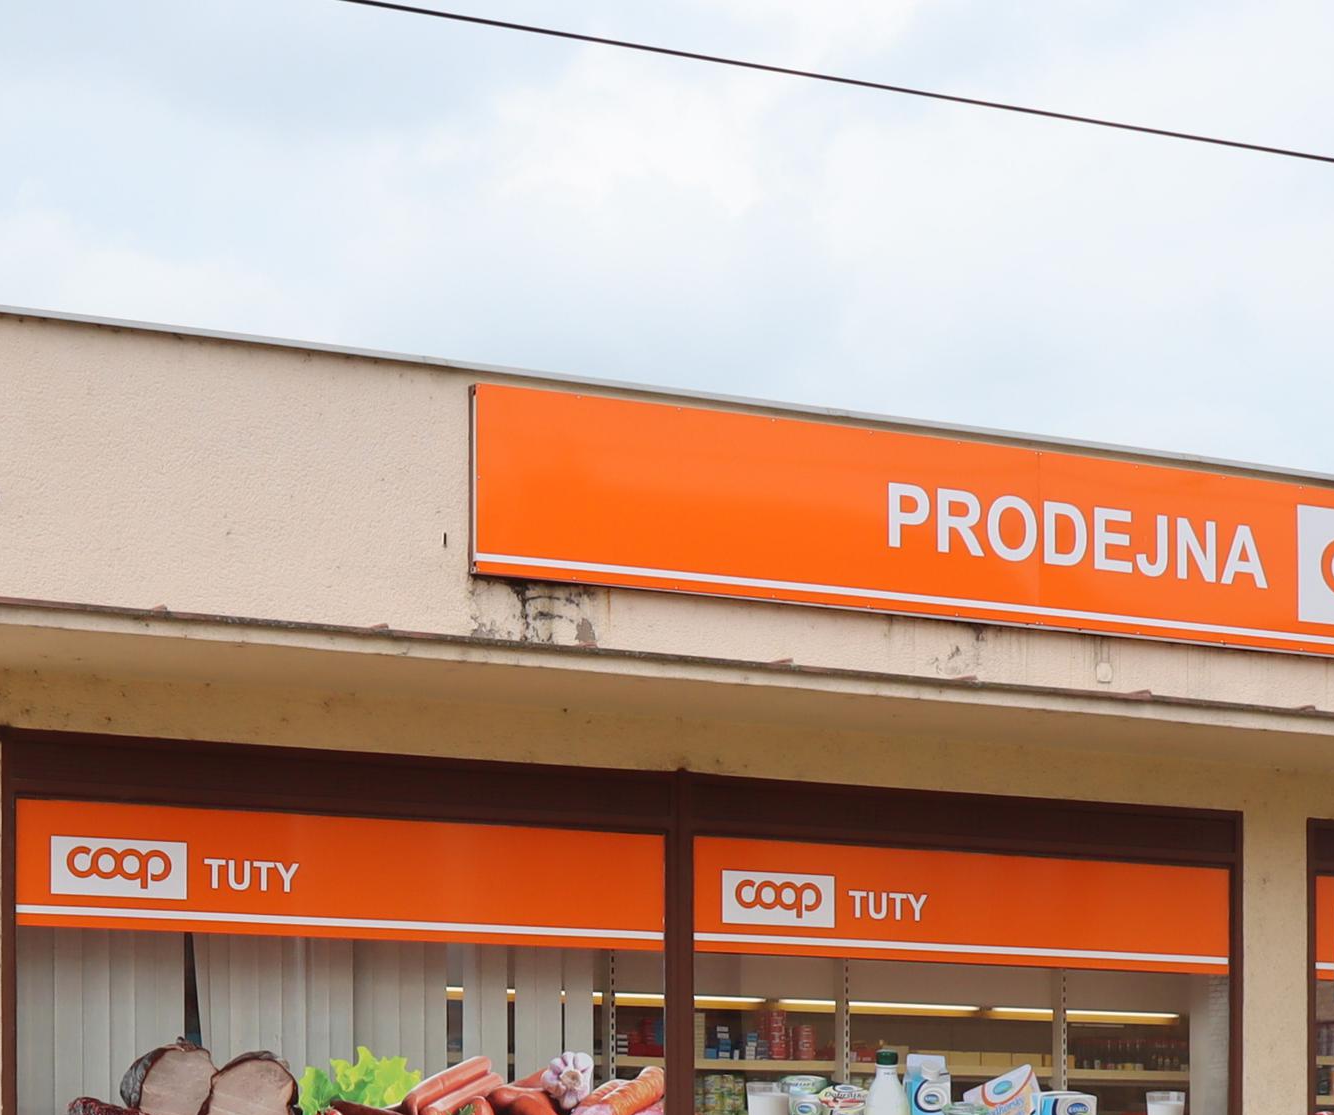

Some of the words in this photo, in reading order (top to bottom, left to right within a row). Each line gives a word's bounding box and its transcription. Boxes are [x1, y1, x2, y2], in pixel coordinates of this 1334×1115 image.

[887, 481, 1269, 589] PRODEJNA
[66, 845, 172, 889] coop
[203, 858, 300, 893] TUTY
[734, 879, 822, 918] coop
[848, 890, 928, 921] TUTY
